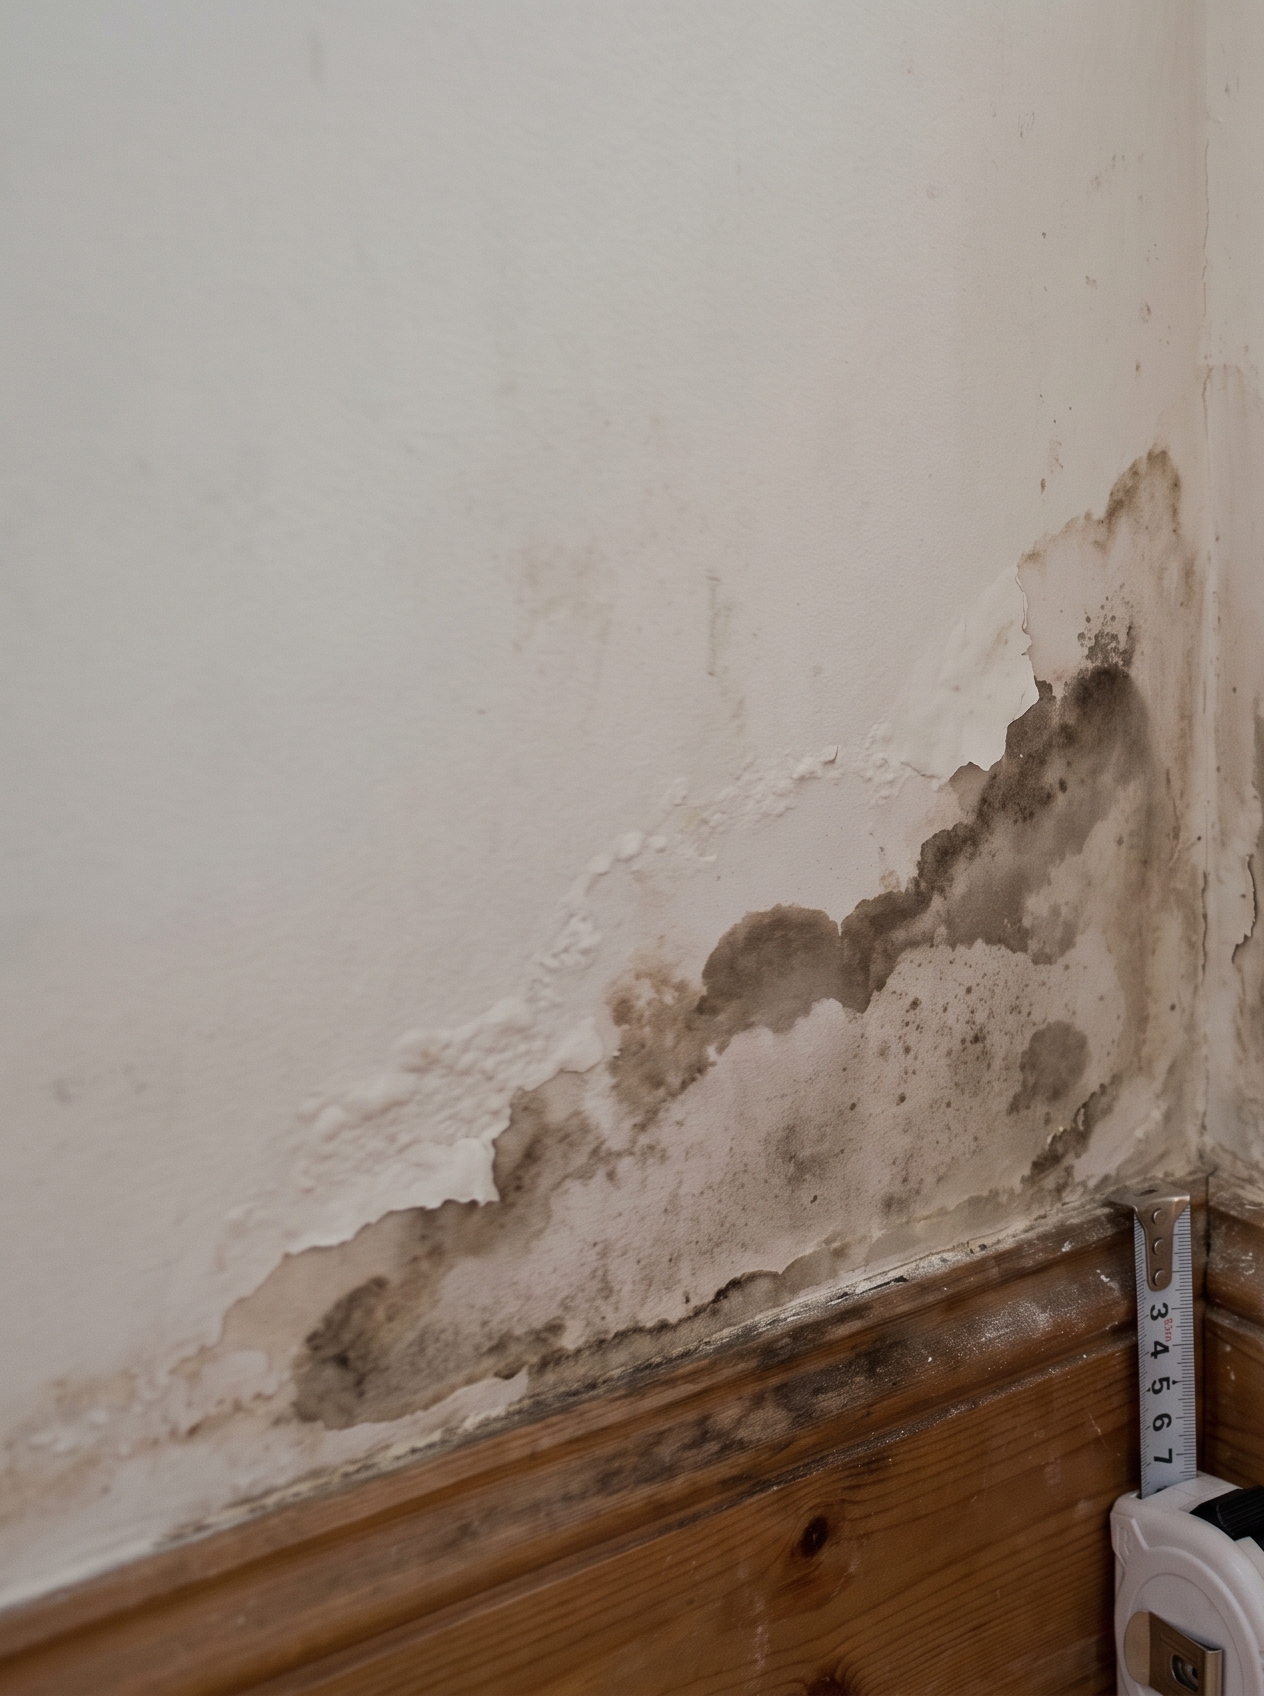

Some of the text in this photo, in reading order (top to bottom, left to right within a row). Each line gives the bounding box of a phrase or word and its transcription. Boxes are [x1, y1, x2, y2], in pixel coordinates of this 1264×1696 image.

[1149, 1302, 1169, 1322] 3
[1149, 1340, 1170, 1360] 4
[1151, 1376, 1171, 1396] 5
[1152, 1412, 1173, 1433] 6
[1152, 1447, 1174, 1465] 7
